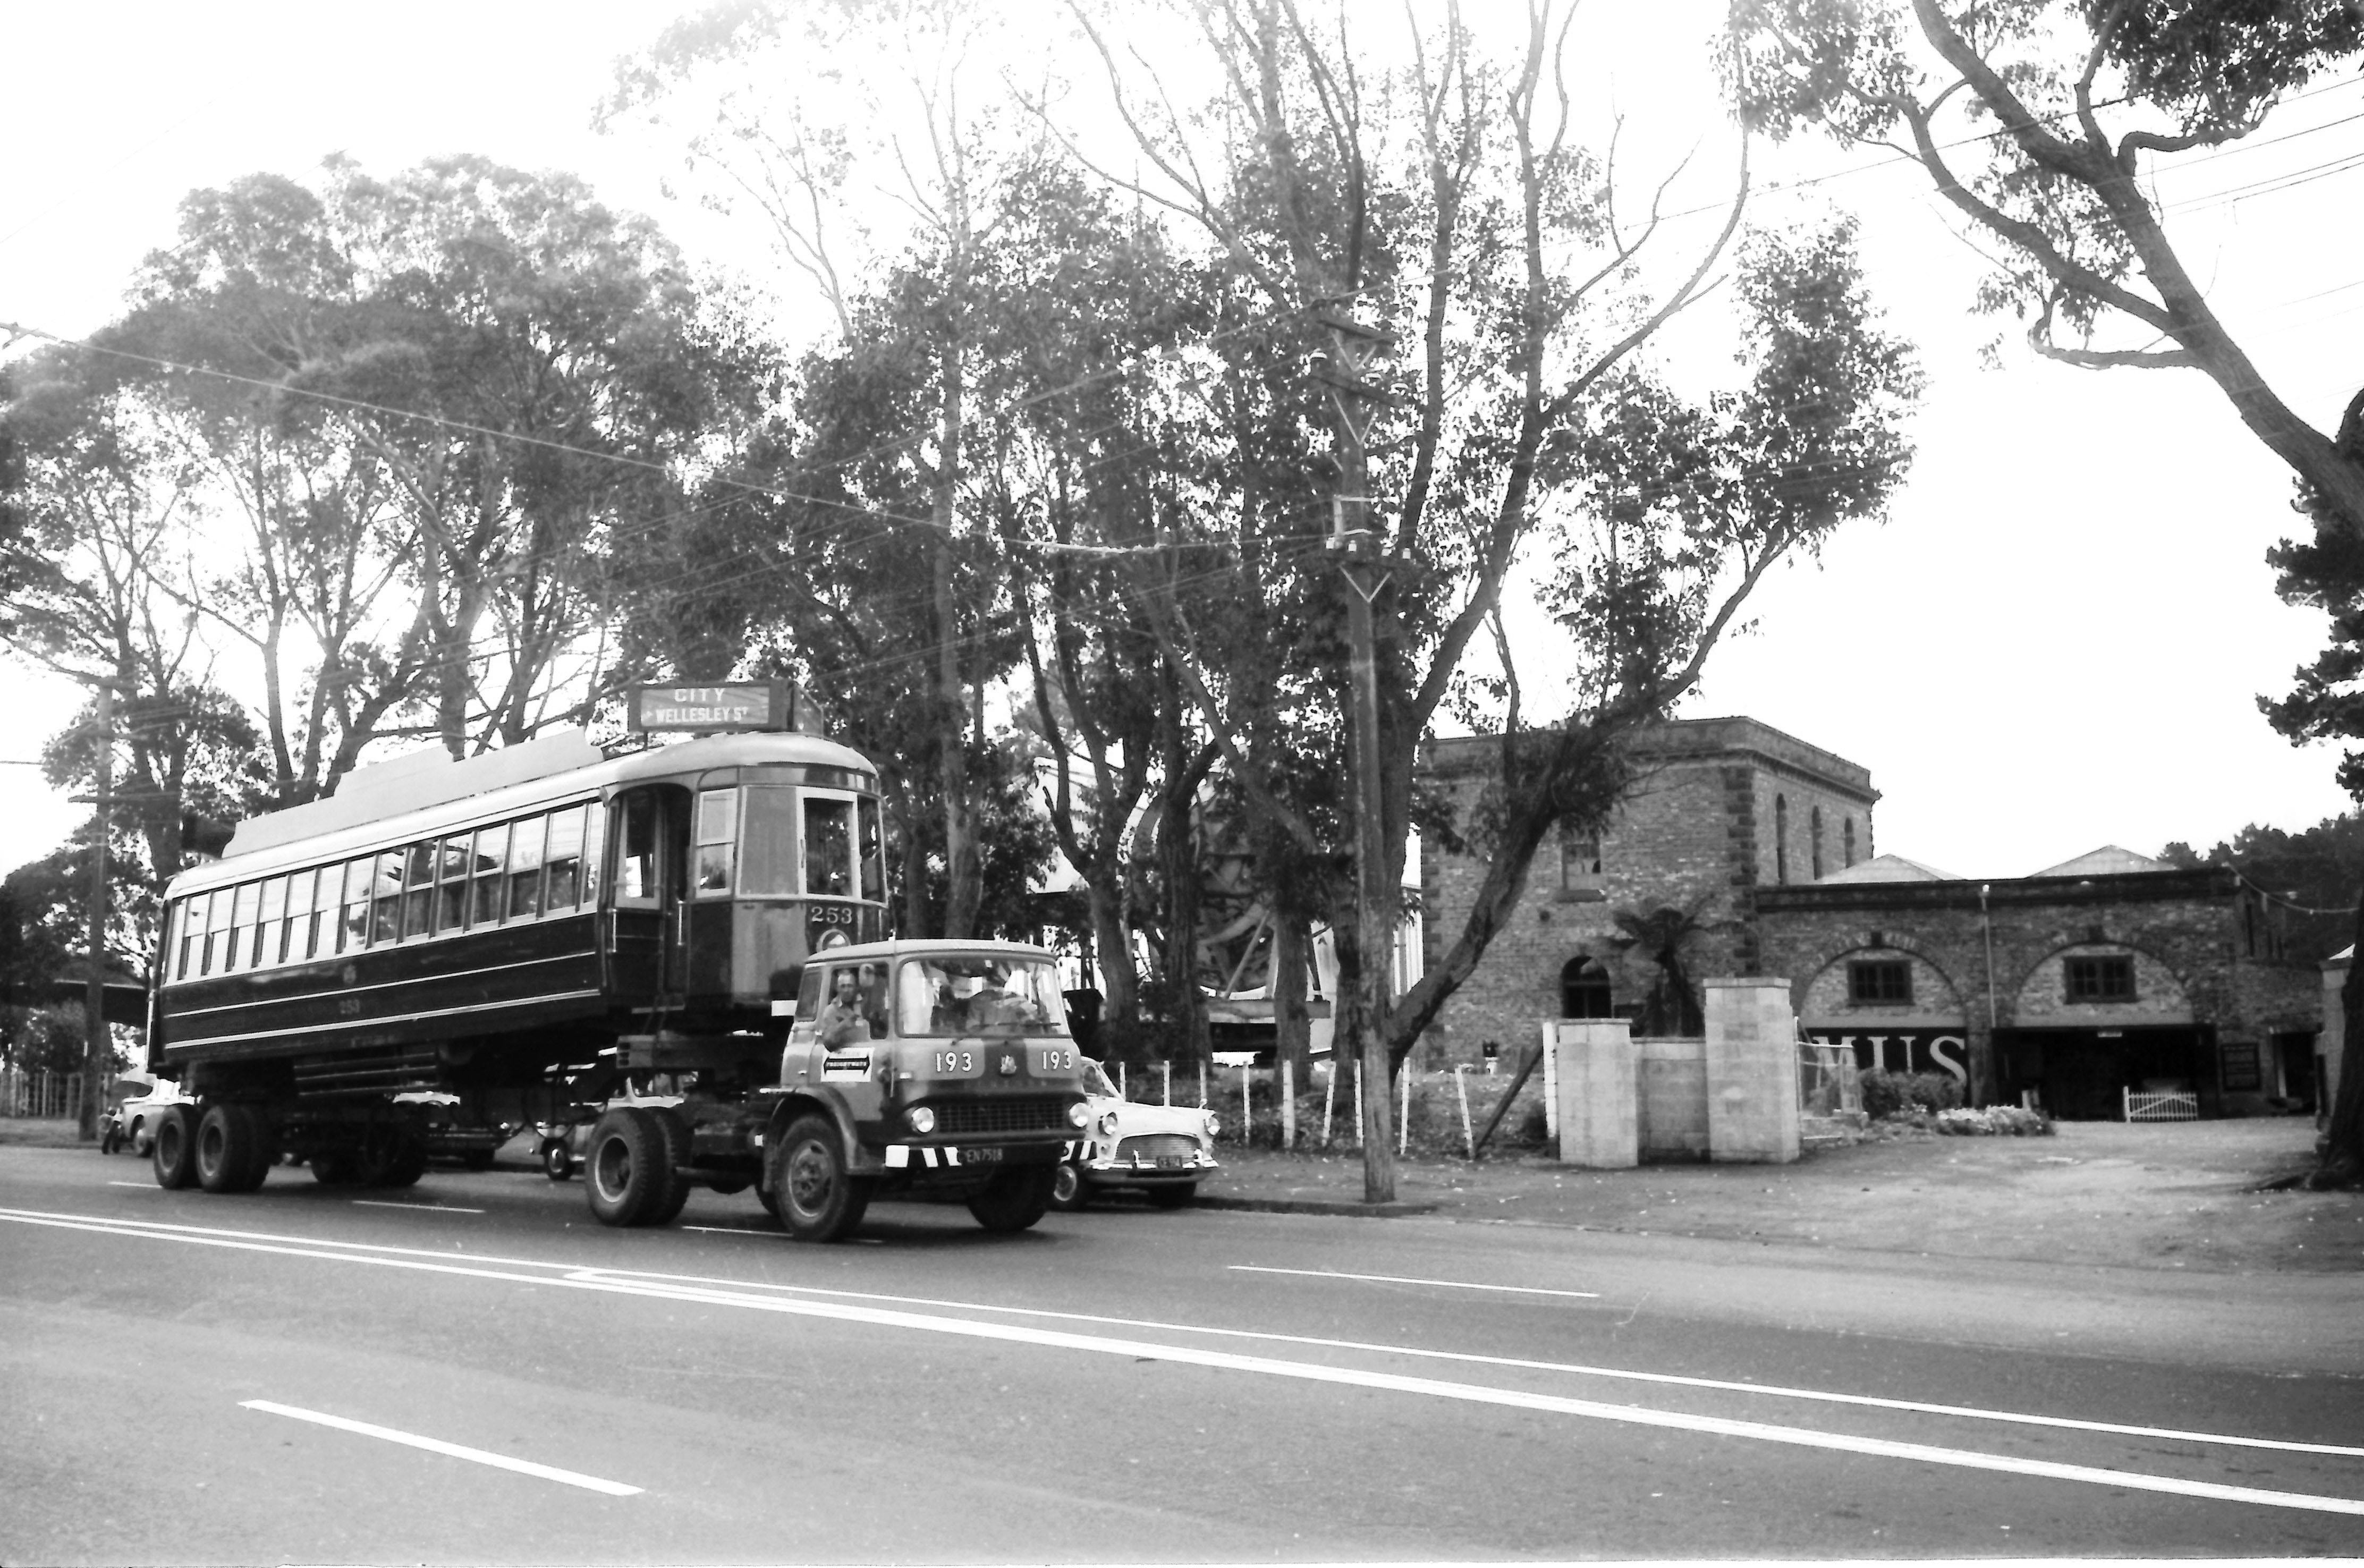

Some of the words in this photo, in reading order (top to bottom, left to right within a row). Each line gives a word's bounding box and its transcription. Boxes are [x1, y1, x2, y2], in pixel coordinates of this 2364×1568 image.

[674, 688, 725, 702] CITY
[656, 707, 730, 723] WELLESLEY
[811, 906, 852, 924] 253
[935, 1052, 972, 1072] 193
[1043, 1051, 1072, 1070] 193
